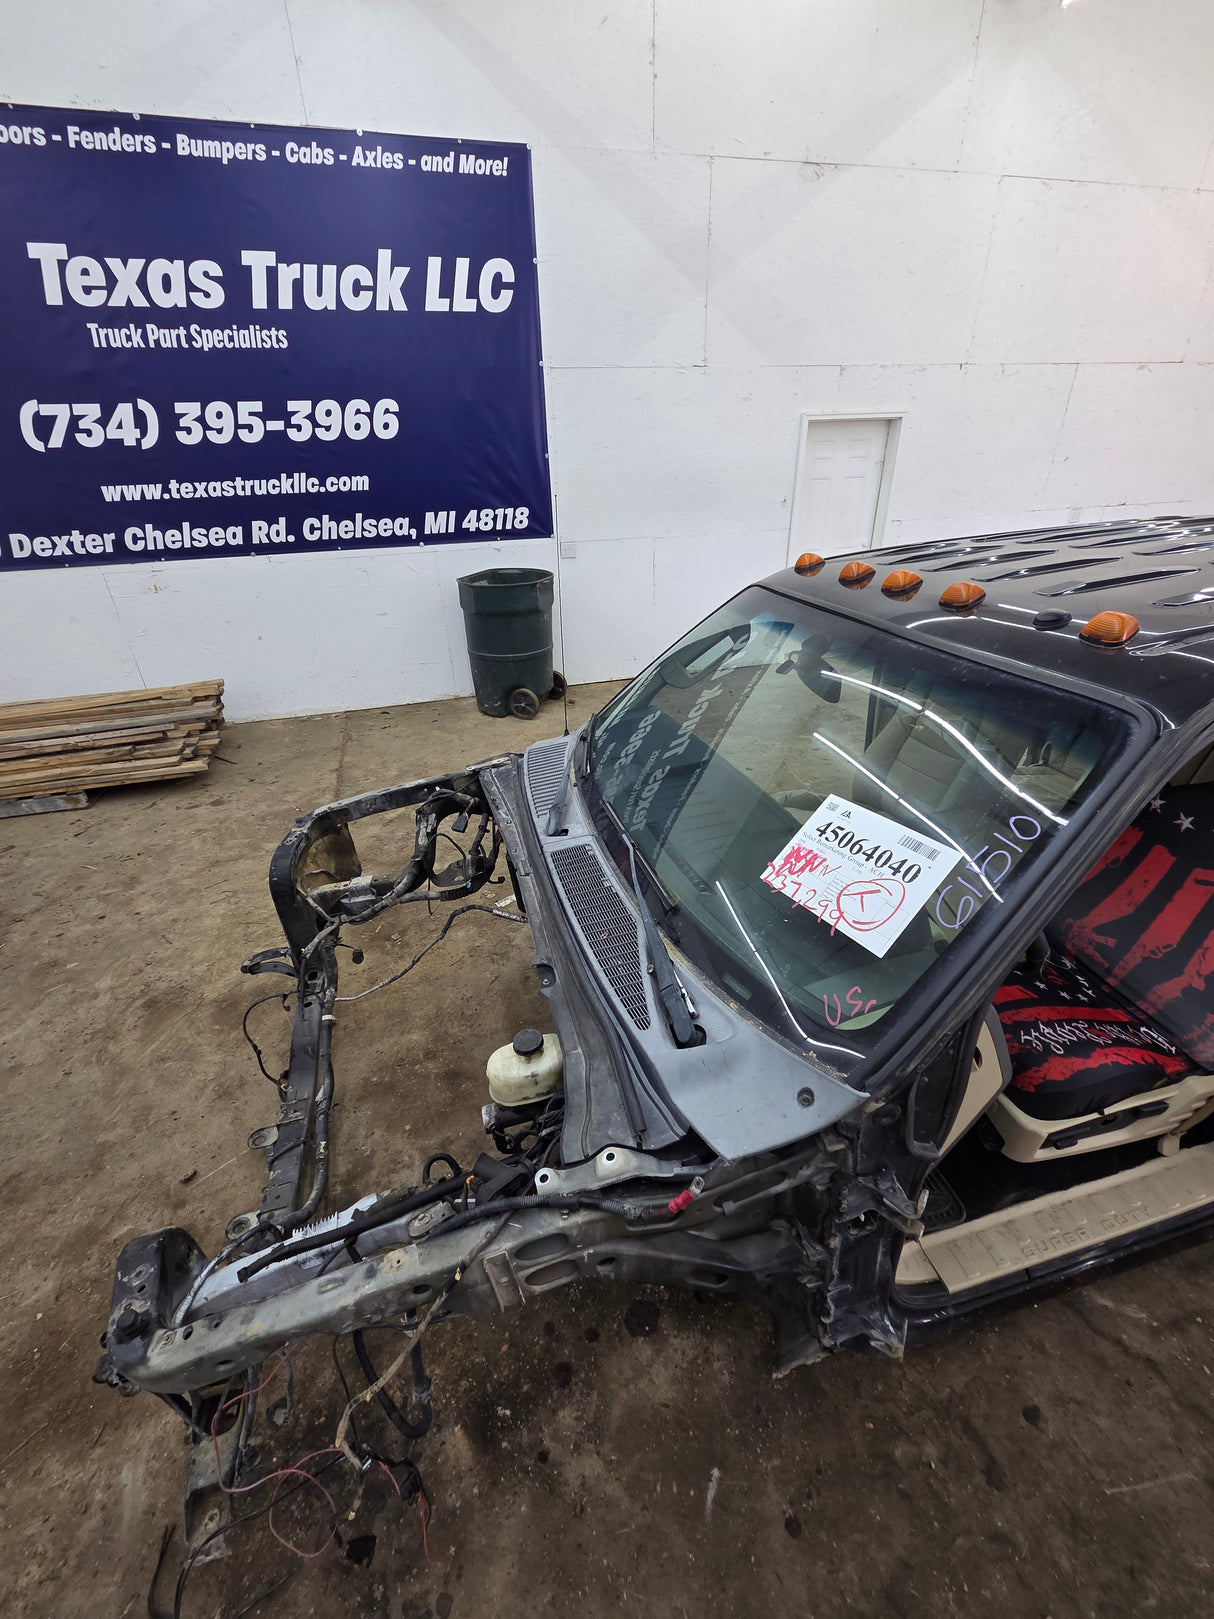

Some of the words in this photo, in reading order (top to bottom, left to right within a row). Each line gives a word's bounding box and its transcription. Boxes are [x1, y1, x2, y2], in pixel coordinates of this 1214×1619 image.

[67, 126, 156, 153] Fenders
[177, 134, 266, 164] Bumpers
[286, 142, 334, 165] Cabs
[352, 146, 403, 169] Axles
[421, 152, 454, 172] and
[459, 154, 508, 176] More!
[27, 242, 225, 308] Texas
[241, 249, 410, 311] Truck
[425, 257, 514, 313] LLC
[87, 323, 145, 347] Truck
[146, 324, 188, 348] Part
[190, 324, 288, 351] Specialists
[20, 399, 158, 452] (734)
[174, 399, 399, 444] 395-3966
[101, 473, 369, 501] www.texastruckllc.com
[9, 531, 115, 558] Dexter
[125, 522, 243, 551] Chelsea
[252, 517, 295, 543] Rd.
[303, 513, 416, 540] Chelsea,
[425, 511, 455, 534] MI
[462, 507, 529, 531] 48118
[815, 821, 922, 884] 45064040
